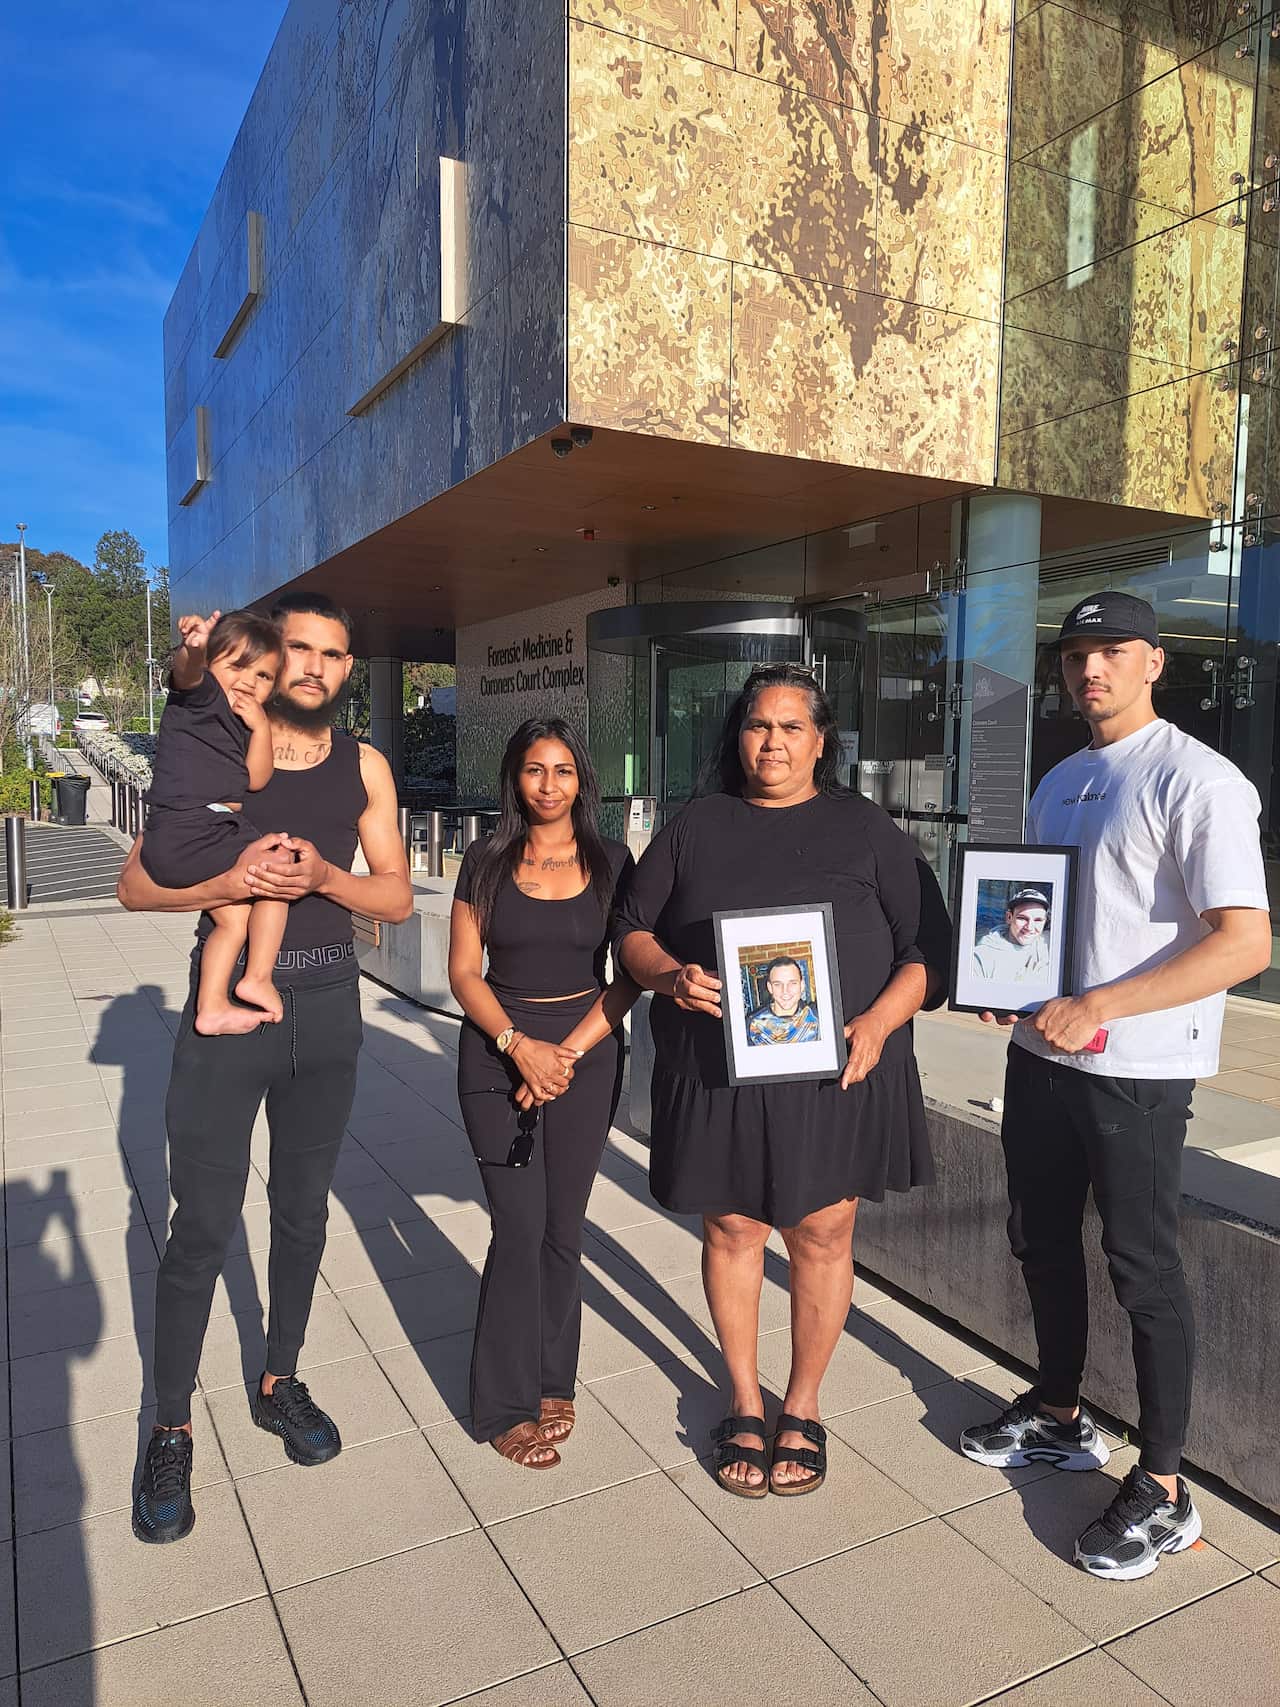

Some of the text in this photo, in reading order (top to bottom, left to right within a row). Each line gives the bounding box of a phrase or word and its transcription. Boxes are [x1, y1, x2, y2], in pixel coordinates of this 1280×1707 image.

[487, 628, 574, 667] Forensic Medicine &
[480, 660, 585, 696] Coroners Court Complex
